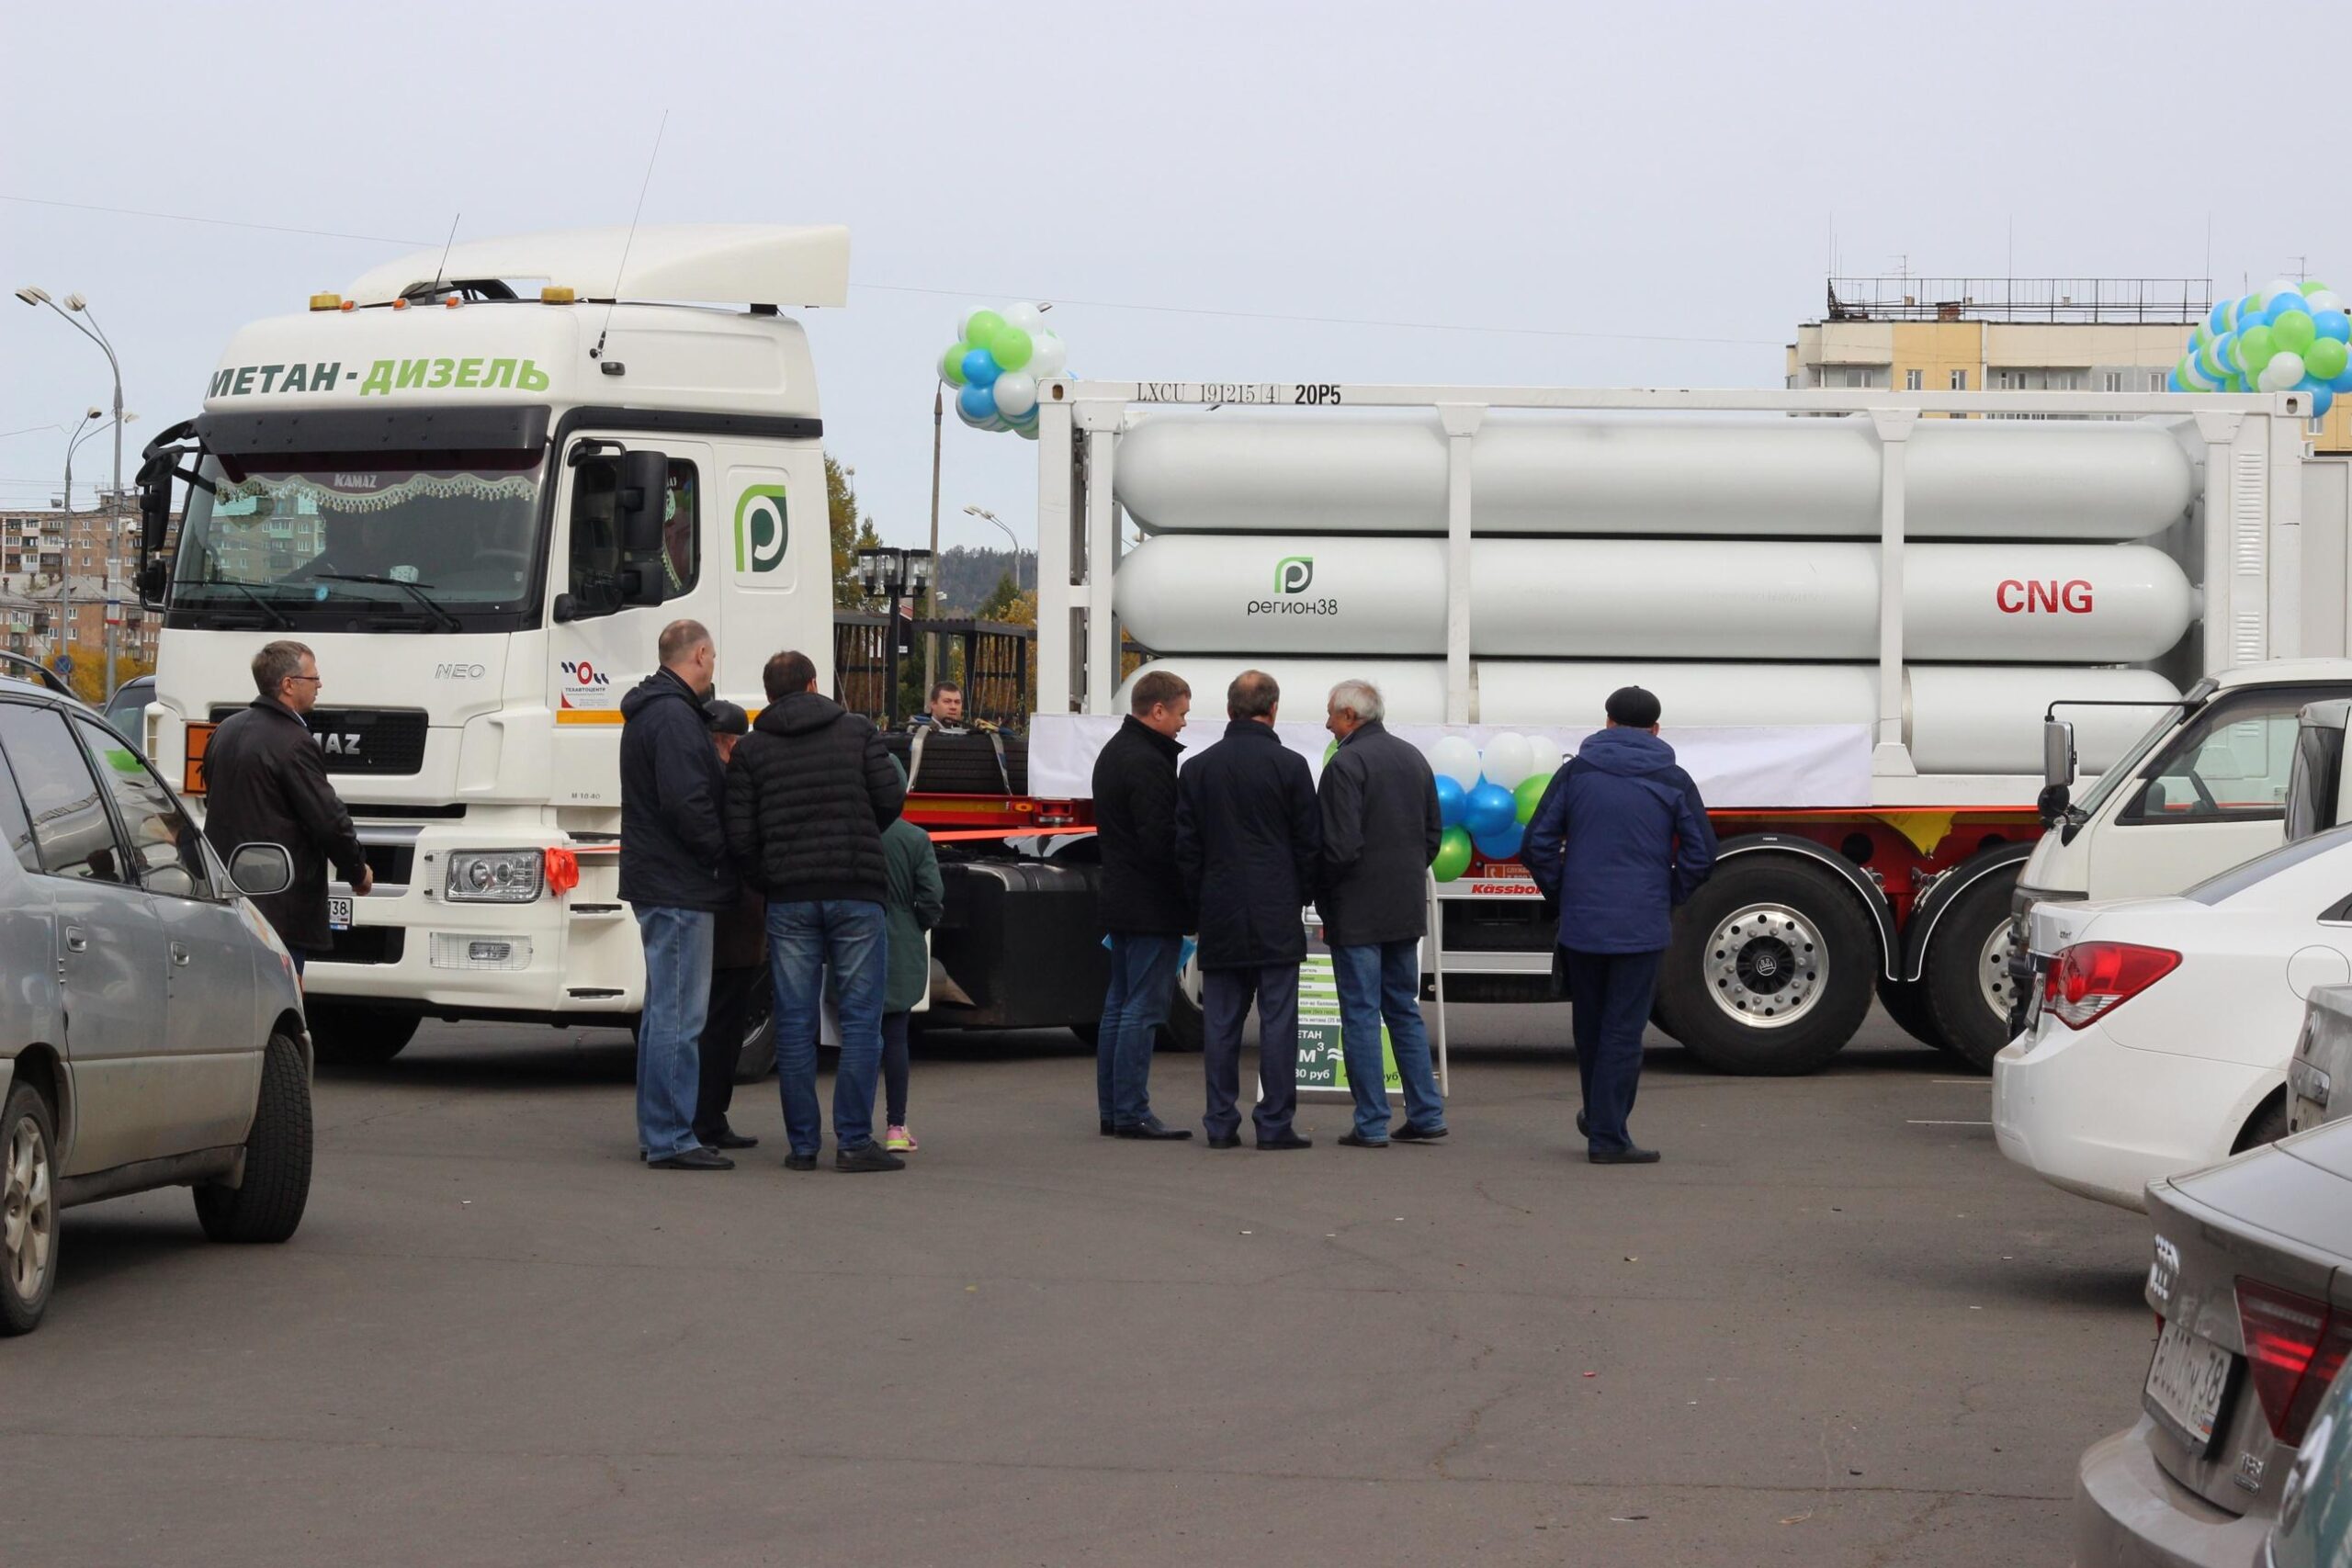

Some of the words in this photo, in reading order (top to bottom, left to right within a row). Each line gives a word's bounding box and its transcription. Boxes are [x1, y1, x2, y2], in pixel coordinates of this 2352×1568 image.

[1137, 382, 1185, 402] LXCU
[1200, 384, 1255, 404] 191215
[1295, 384, 1341, 405] 20P5
[334, 473, 377, 488] KAMAZ
[1996, 580, 2093, 614] CNG
[1248, 598, 1338, 616] регион38
[435, 663, 486, 680] NEO
[1297, 1030, 1322, 1039] ЕТАН
[1309, 1069, 1330, 1081] руб
[1384, 1071, 1399, 1082] уб
